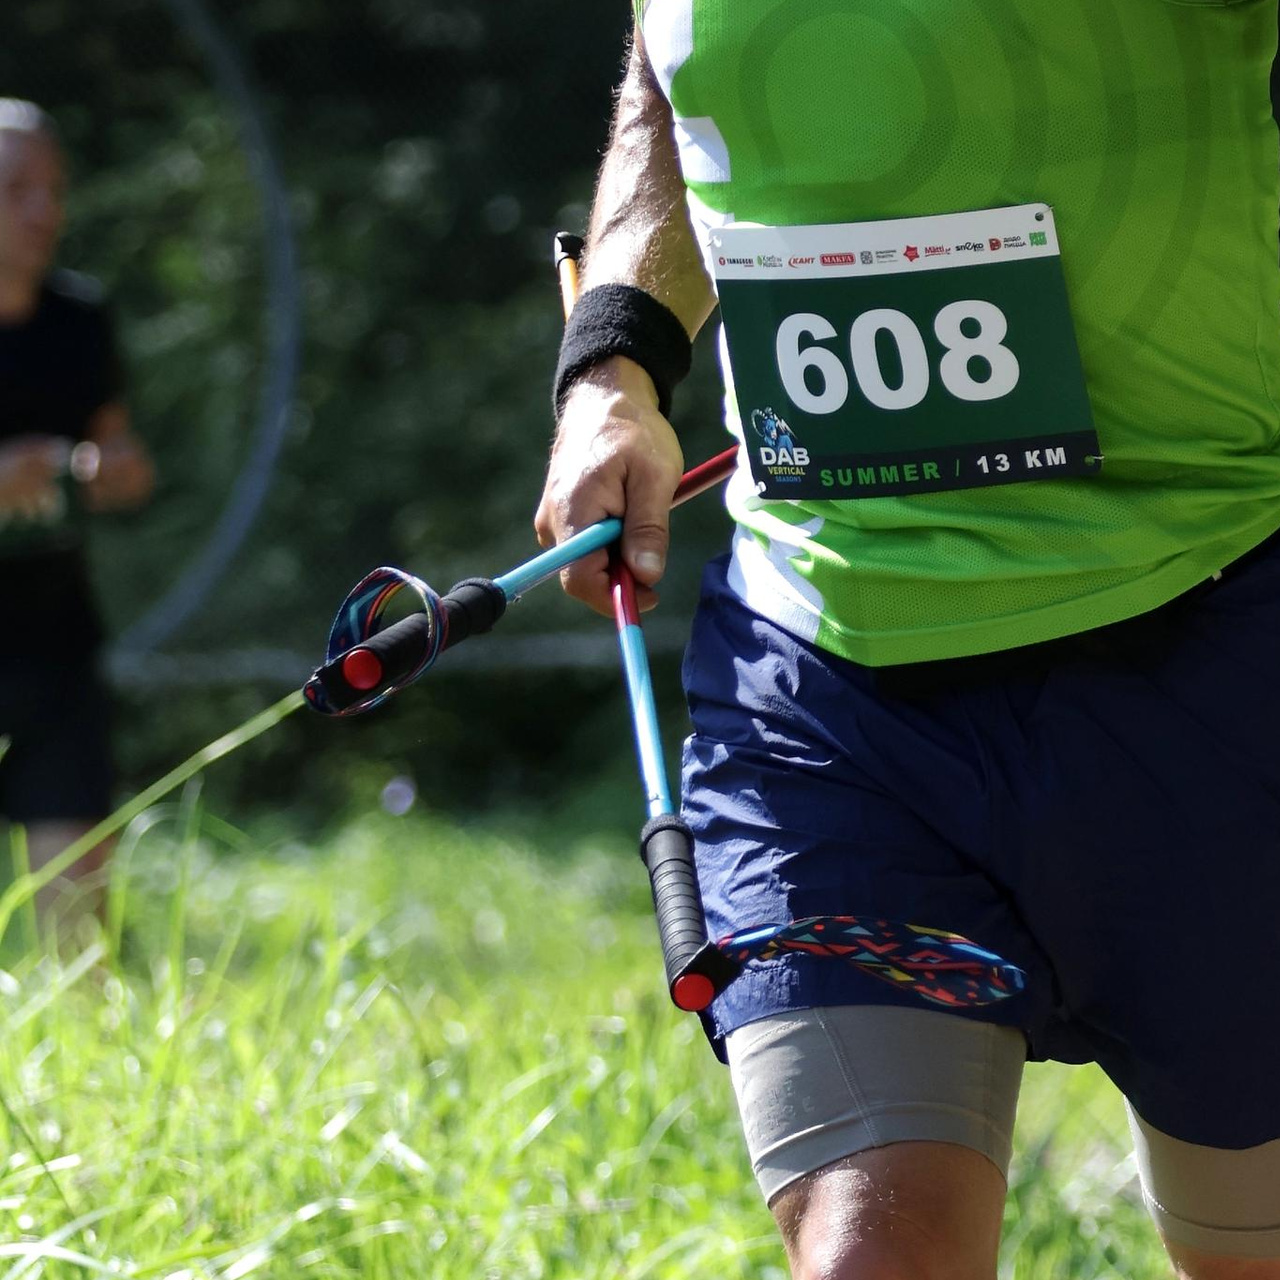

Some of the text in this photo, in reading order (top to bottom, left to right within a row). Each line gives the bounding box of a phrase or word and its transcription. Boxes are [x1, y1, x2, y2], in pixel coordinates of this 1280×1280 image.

[776, 299, 1020, 414] 608
[760, 446, 810, 466] DAB
[767, 466, 806, 475] VERTICAL
[820, 461, 941, 487] SUMMER
[976, 453, 1010, 474] 13
[1025, 447, 1067, 469] KM
